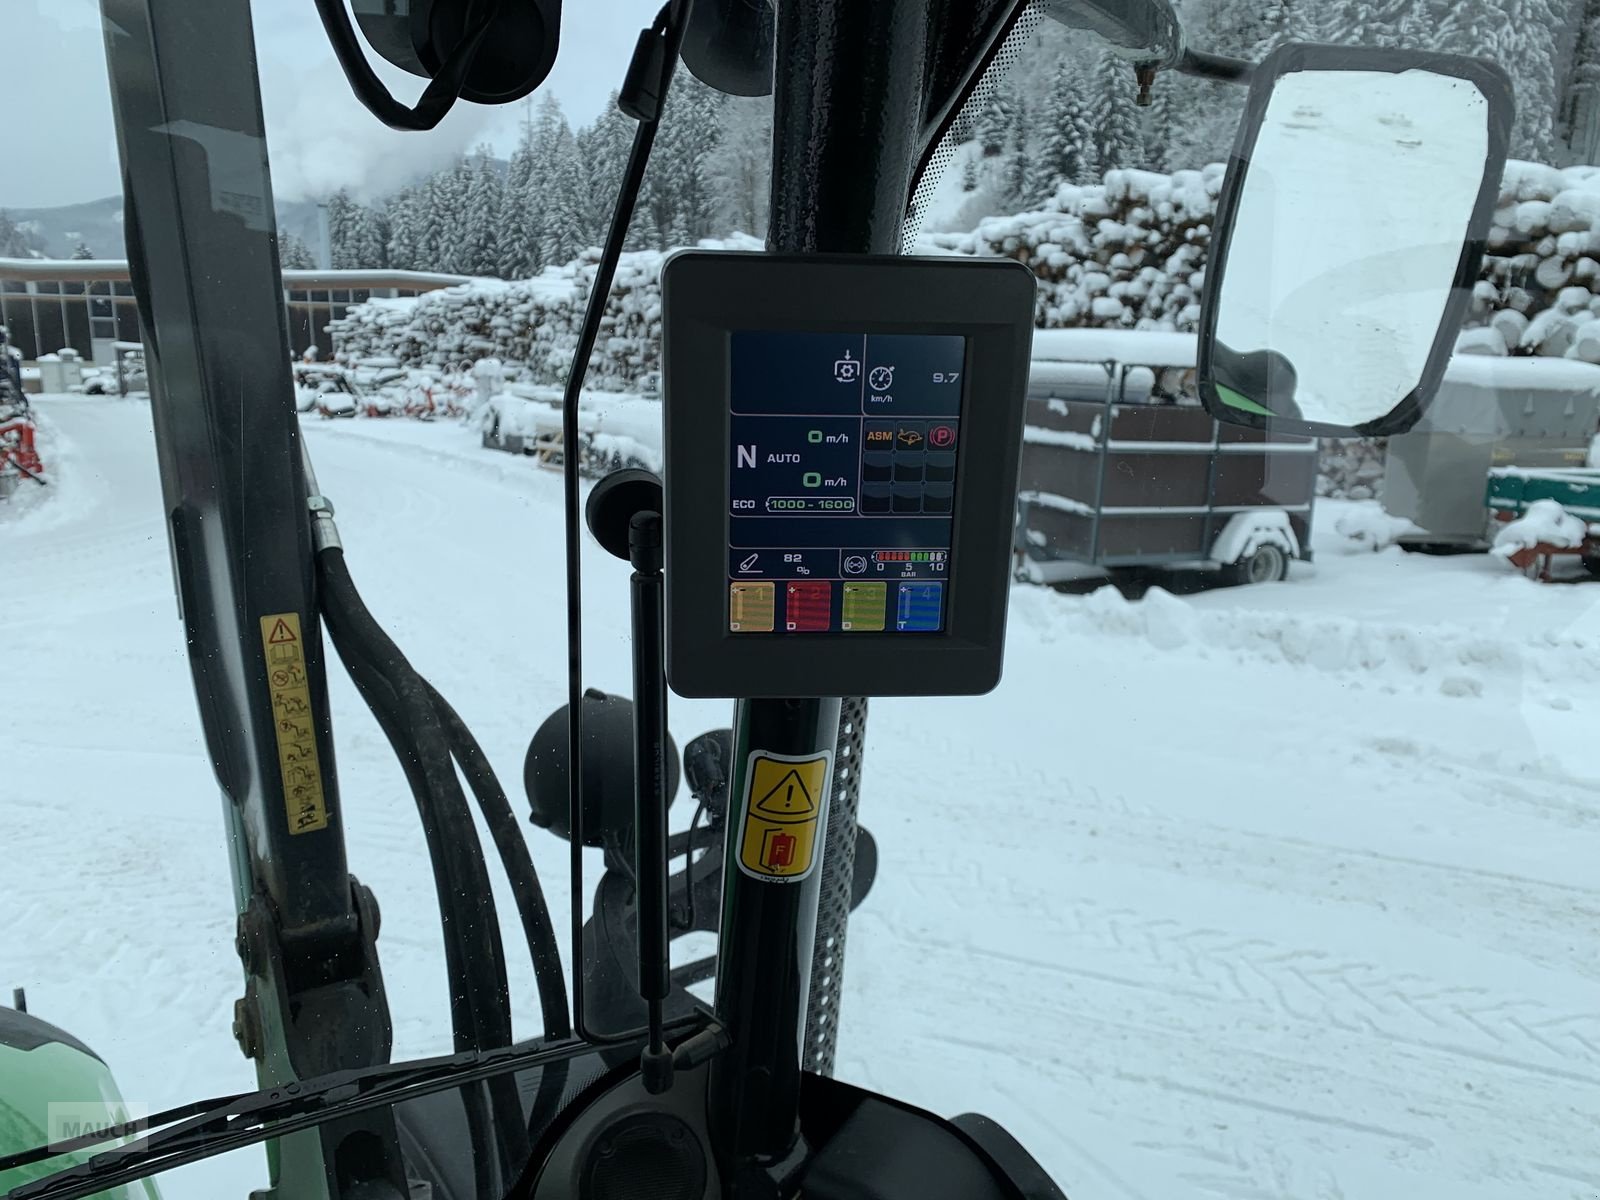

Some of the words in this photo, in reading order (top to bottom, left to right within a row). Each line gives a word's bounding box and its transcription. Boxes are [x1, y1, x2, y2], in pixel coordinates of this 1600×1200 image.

[932, 372, 959, 383] 9.7
[870, 394, 893, 403] km/h
[808, 430, 823, 444] 0
[826, 433, 849, 444] m/h
[867, 431, 893, 441] ASM
[737, 444, 757, 469] N
[767, 453, 801, 464] AUTO
[802, 471, 822, 488] 0
[824, 476, 847, 487] m/h
[732, 499, 756, 509] ECO
[770, 500, 806, 510] 1000
[818, 500, 853, 510] 1600
[783, 553, 803, 563] 82
[876, 562, 885, 571] 0
[905, 562, 913, 571] 5
[929, 562, 944, 571] 10
